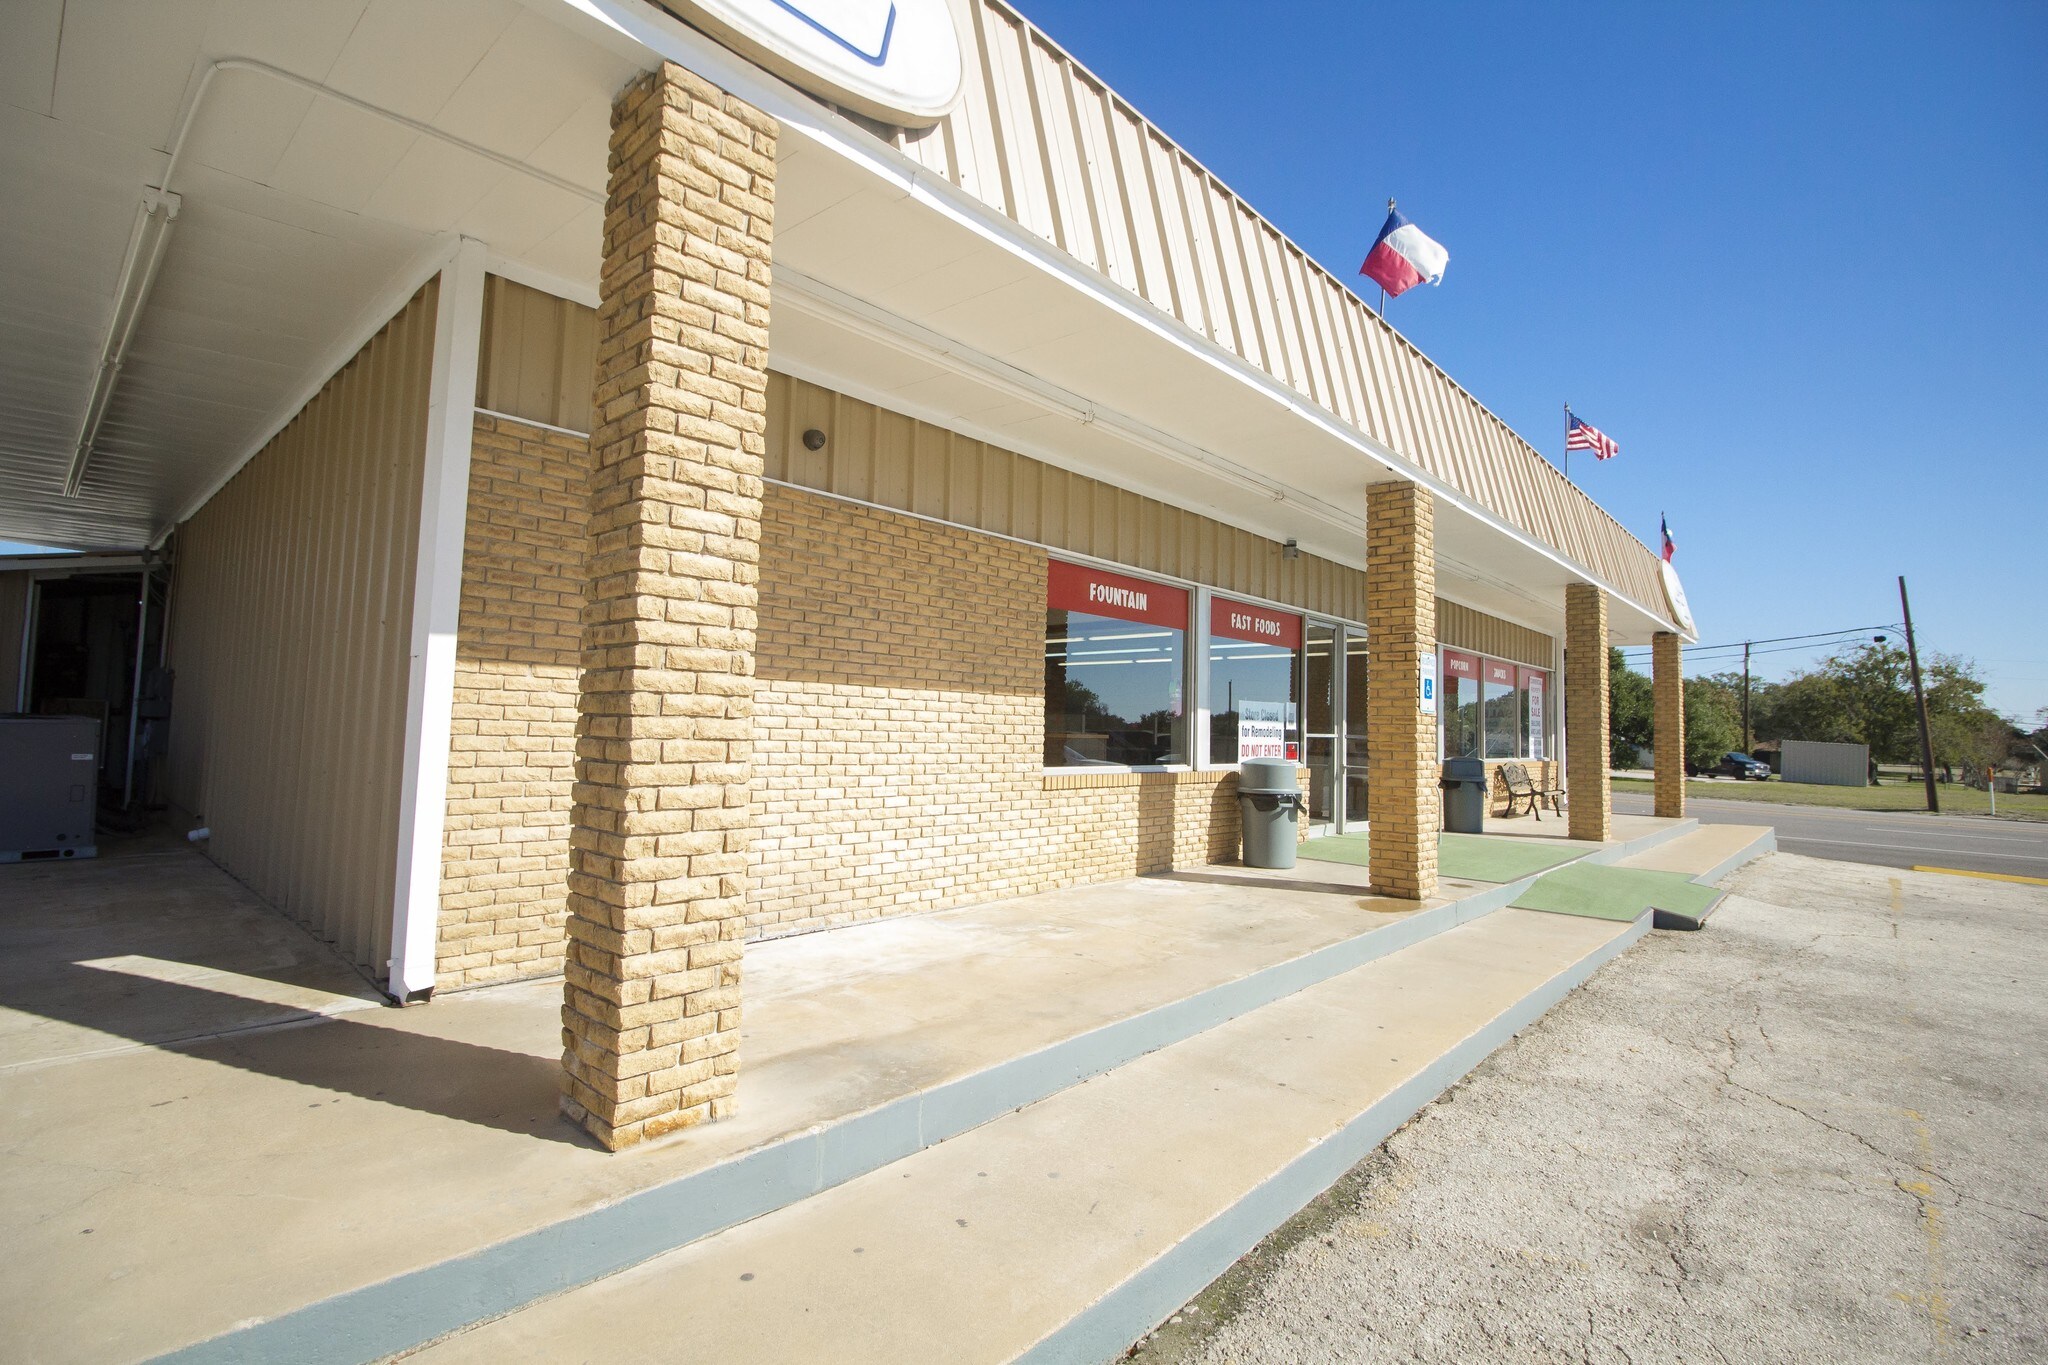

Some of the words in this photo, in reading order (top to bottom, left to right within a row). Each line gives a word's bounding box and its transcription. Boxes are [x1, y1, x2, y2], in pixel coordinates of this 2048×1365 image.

[1090, 582, 1147, 611] FOUNTAIN
[1231, 612, 1251, 631] FAST
[1255, 617, 1280, 636] FOODS
[1450, 659, 1469, 672] POPCORN
[1244, 707, 1260, 720] Store
[1261, 708, 1279, 721] Closed
[1241, 725, 1250, 738] for
[1251, 725, 1282, 740] Remodeling
[1241, 744, 1250, 757] DO
[1251, 744, 1263, 757] NOT
[1264, 744, 1282, 757] ENTER
